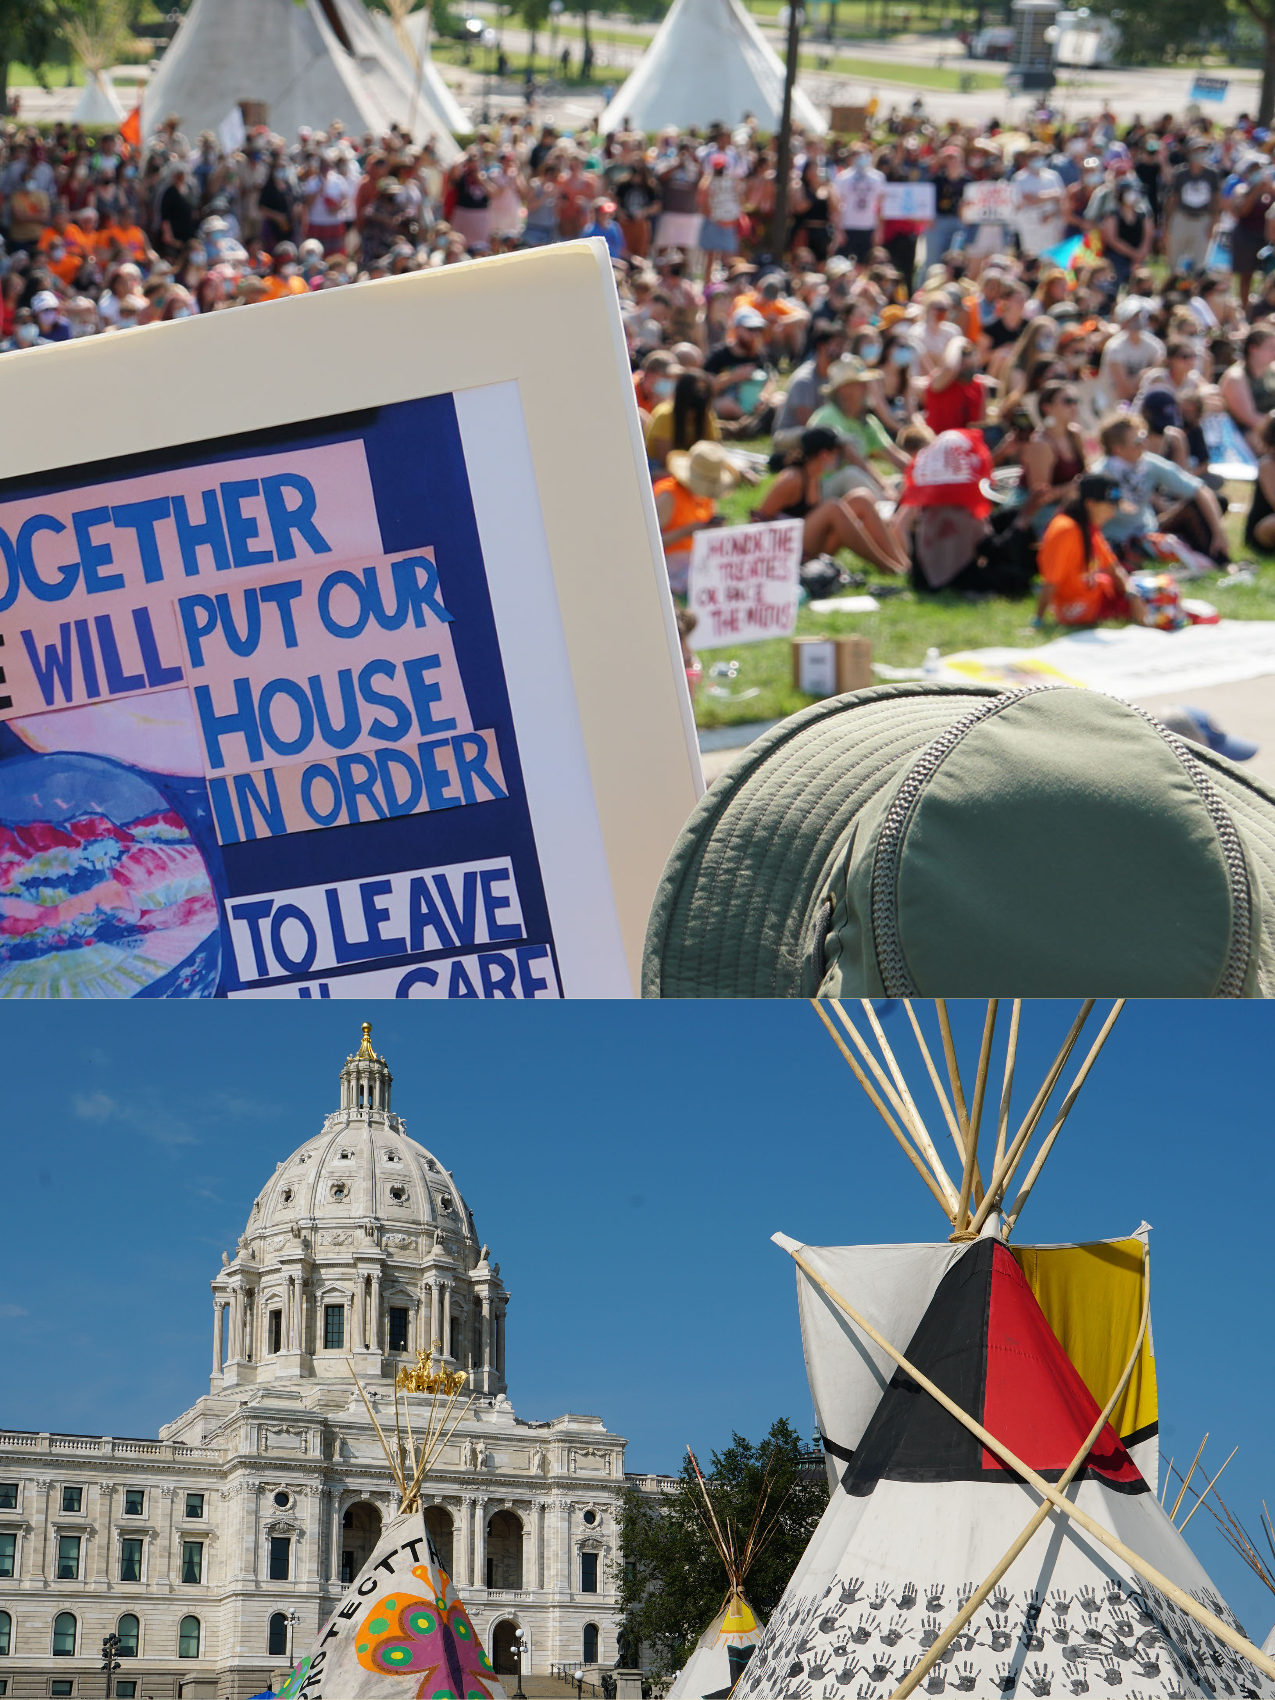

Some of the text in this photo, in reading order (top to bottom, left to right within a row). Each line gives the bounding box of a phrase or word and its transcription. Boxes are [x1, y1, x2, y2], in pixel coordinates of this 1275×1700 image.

[720, 556, 789, 581] TREATIES
[768, 527, 794, 554] THE
[20, 606, 185, 707] WILL
[177, 579, 303, 668] PUT
[318, 555, 456, 639] OUR
[710, 608, 741, 637] THE
[194, 653, 457, 769] HOUSE
[208, 732, 510, 845] IN ORDER
[230, 867, 523, 978] TO LEAVE
[400, 1537, 448, 1574] TH
